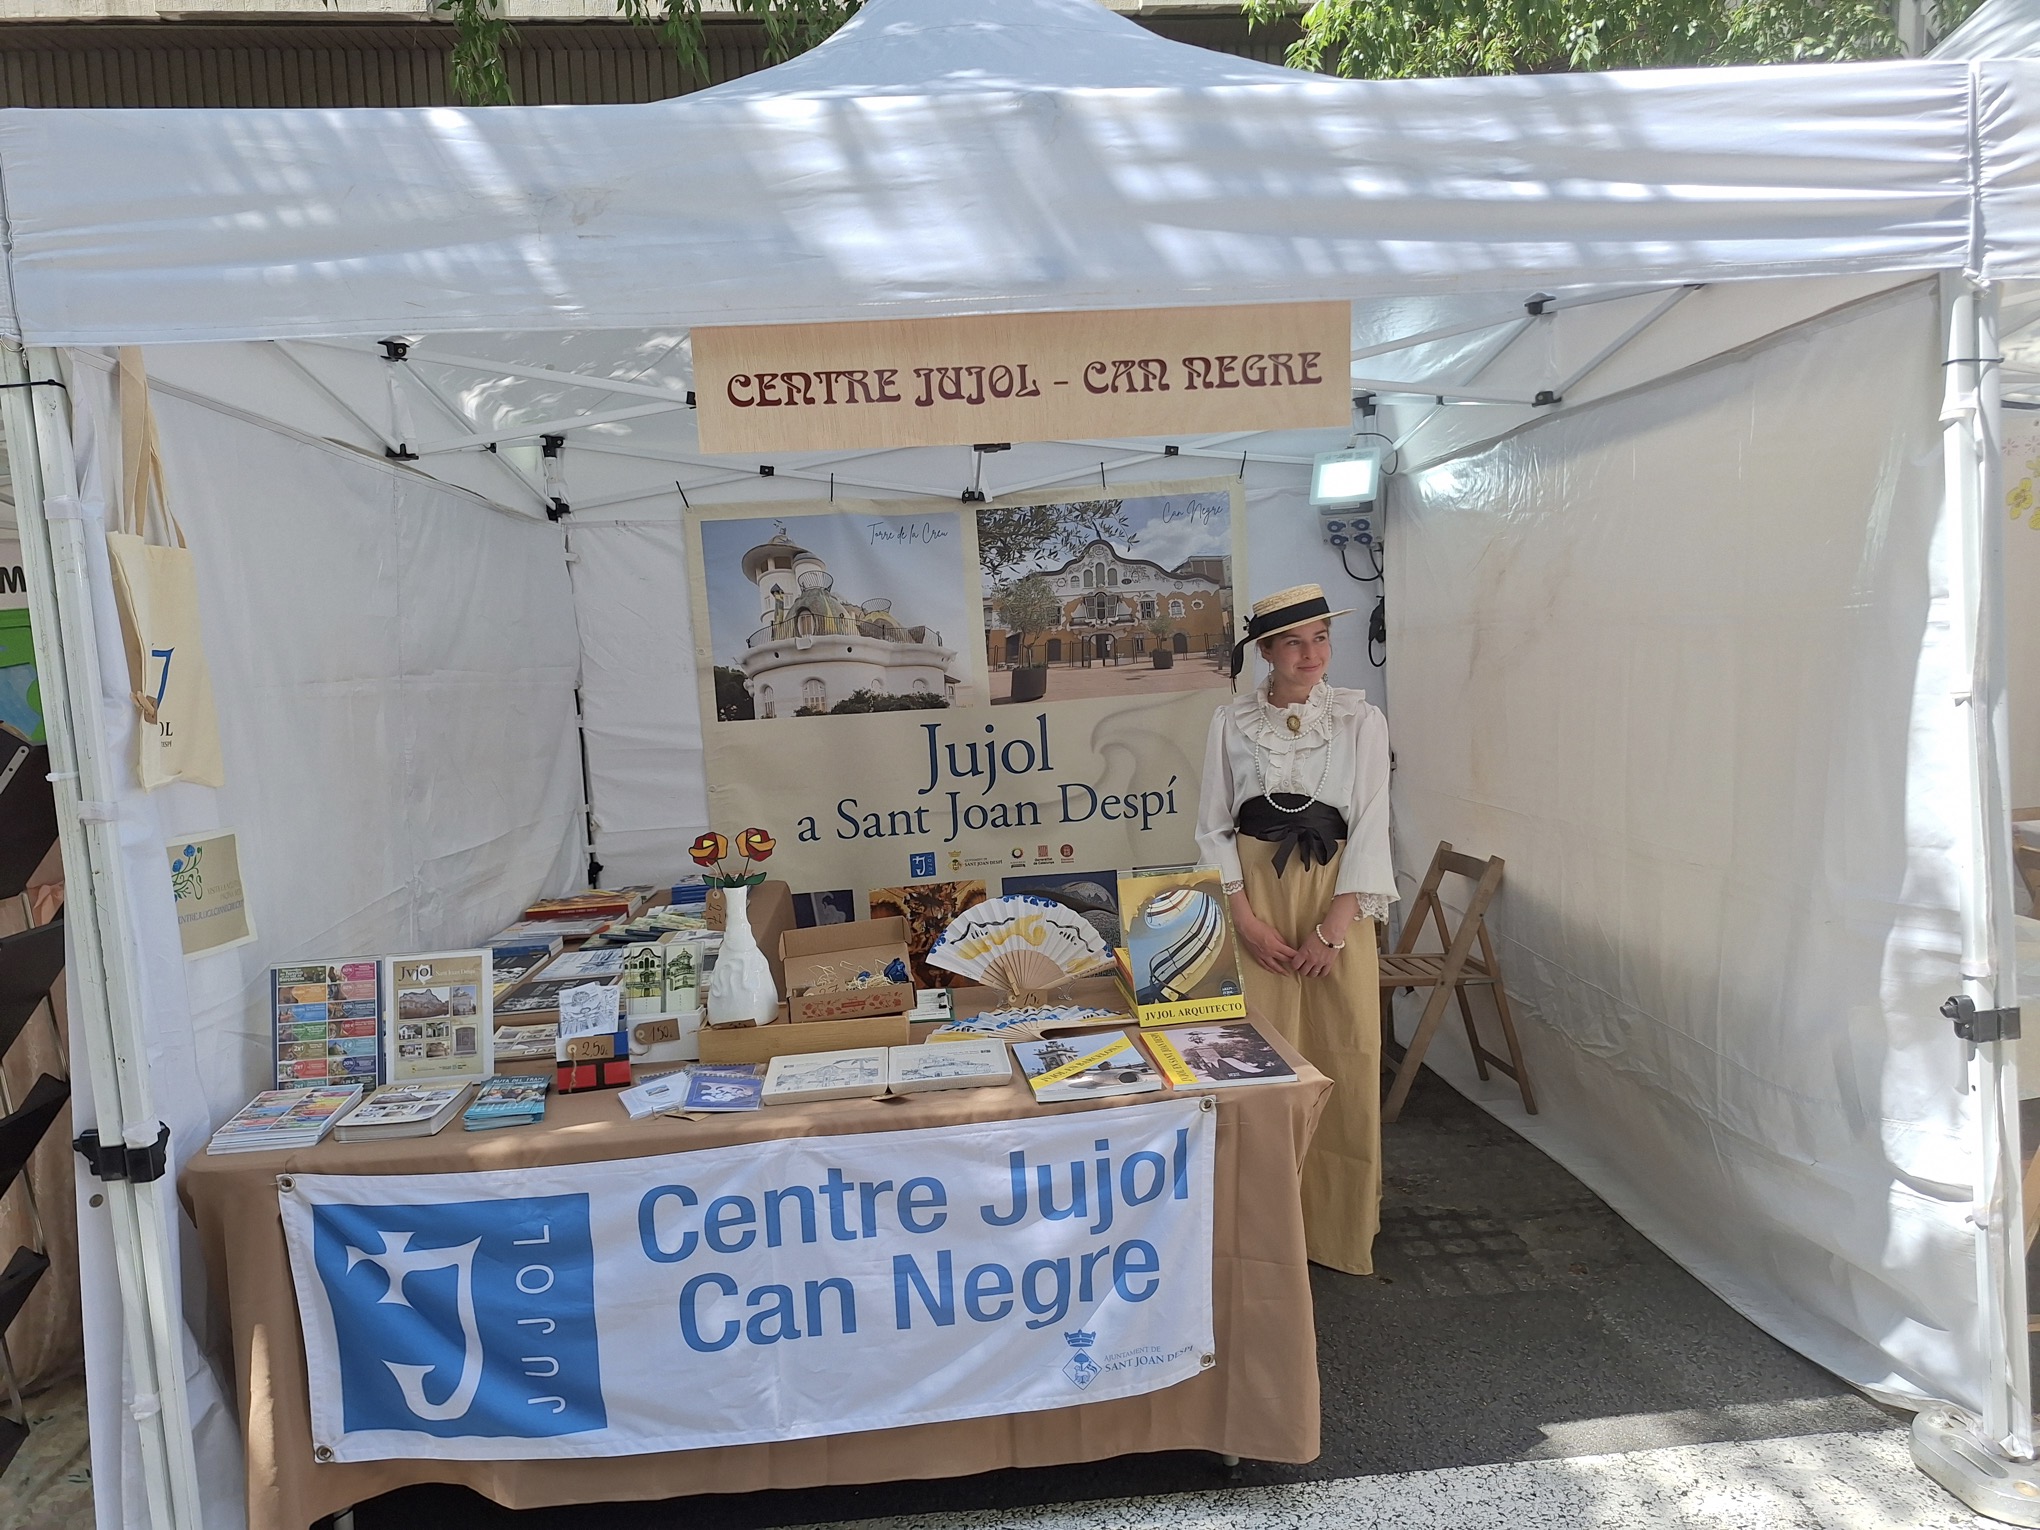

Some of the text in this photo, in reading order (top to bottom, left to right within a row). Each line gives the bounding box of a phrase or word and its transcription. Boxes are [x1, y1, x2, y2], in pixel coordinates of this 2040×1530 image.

[726, 368, 901, 408] CENTRE
[914, 363, 1041, 408] JUJOL
[1082, 358, 1171, 395] CAN
[1182, 351, 1324, 391] NEGRE
[1162, 499, 1225, 526] Can Negre
[866, 523, 896, 546] Torre
[921, 522, 950, 546] Creu
[917, 712, 1055, 796] Jujol
[796, 775, 1179, 843] a Sant Joan Despí
[398, 964, 433, 982] Jvjol
[1145, 1002, 1242, 1021] JVJOL ARQUITECTO
[638, 1128, 1190, 1265] Centre Jujol
[678, 1237, 1161, 1354] Can Negre
[512, 1220, 564, 1417] JUJOL
[1104, 1345, 1161, 1361] AJUNTAMENT DE
[1105, 1359, 1132, 1373] SANT
[1134, 1354, 1165, 1368] JOAN
